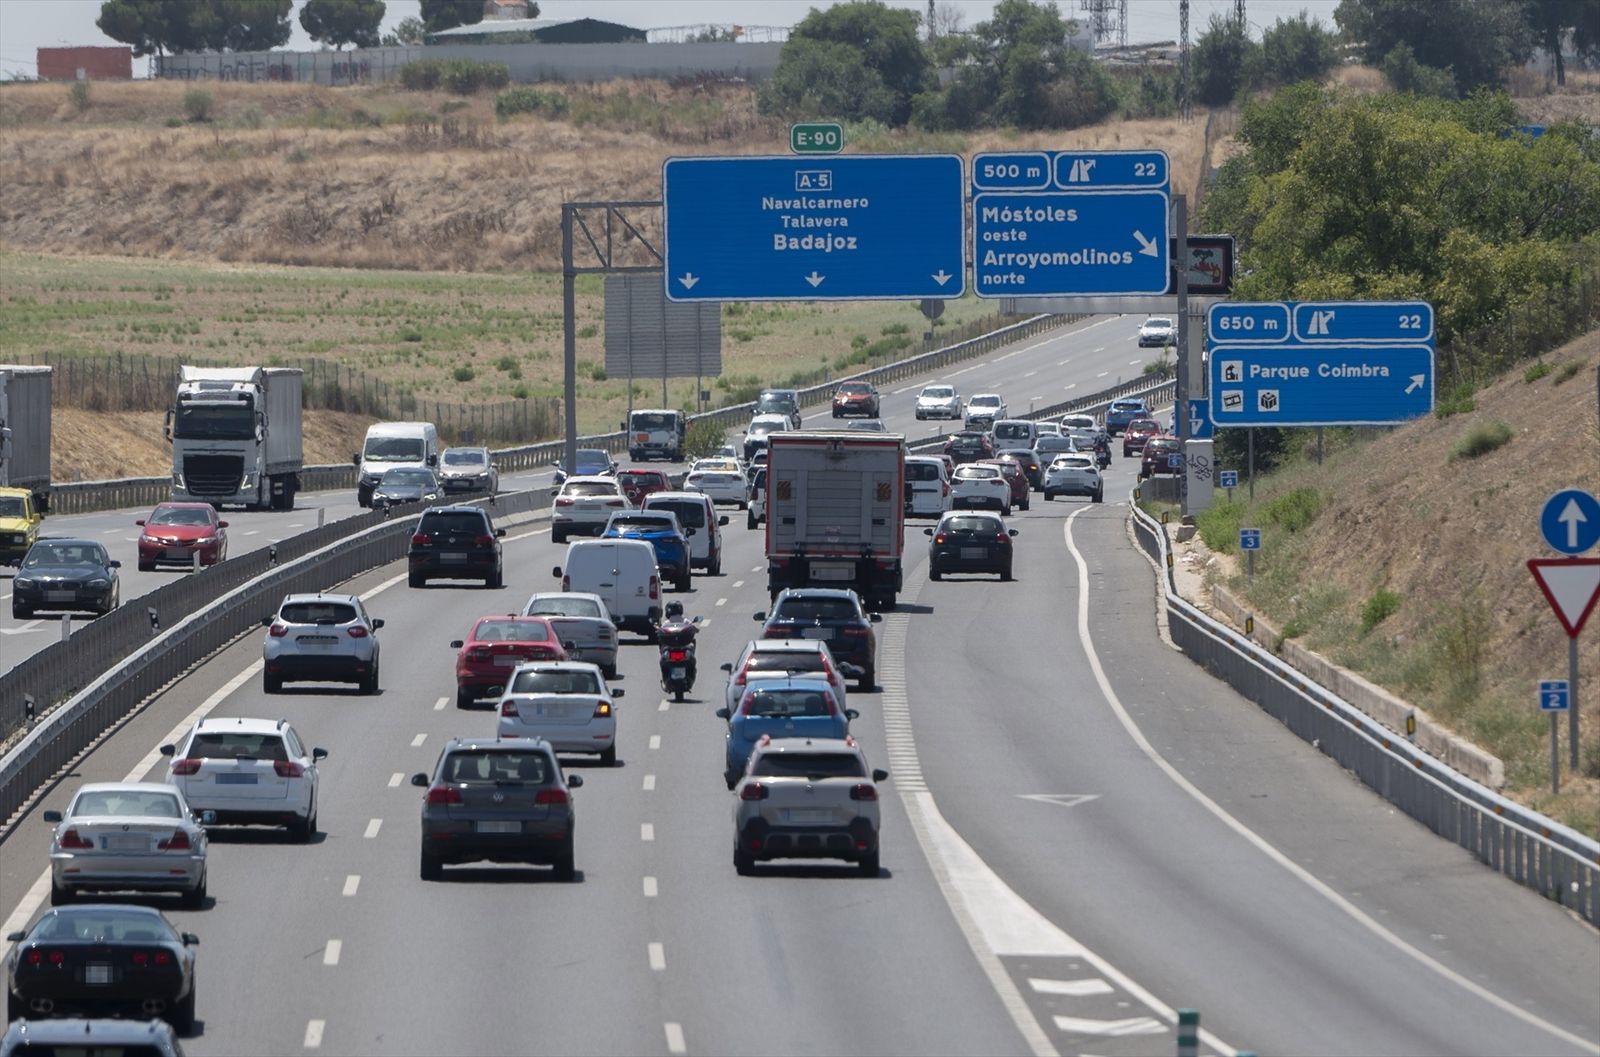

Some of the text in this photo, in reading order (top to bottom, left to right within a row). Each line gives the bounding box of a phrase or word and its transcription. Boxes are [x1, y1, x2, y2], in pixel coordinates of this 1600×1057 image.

[984, 164, 1041, 178] 500 m
[1134, 162, 1157, 177] 22
[762, 196, 869, 210] Navalcarnero
[982, 205, 1078, 223] Móstoles
[780, 215, 848, 228] Talavera
[983, 229, 1027, 242] oeste
[773, 233, 858, 253] Badajoz
[983, 249, 1133, 269] Arroyomolinos
[983, 272, 1026, 286] norte
[1219, 316, 1278, 331] 650 m
[1398, 315, 1421, 329] 22
[1249, 363, 1390, 380] Parque Coimbra
[1247, 538, 1255, 547] 3
[1549, 694, 1560, 707] 2
